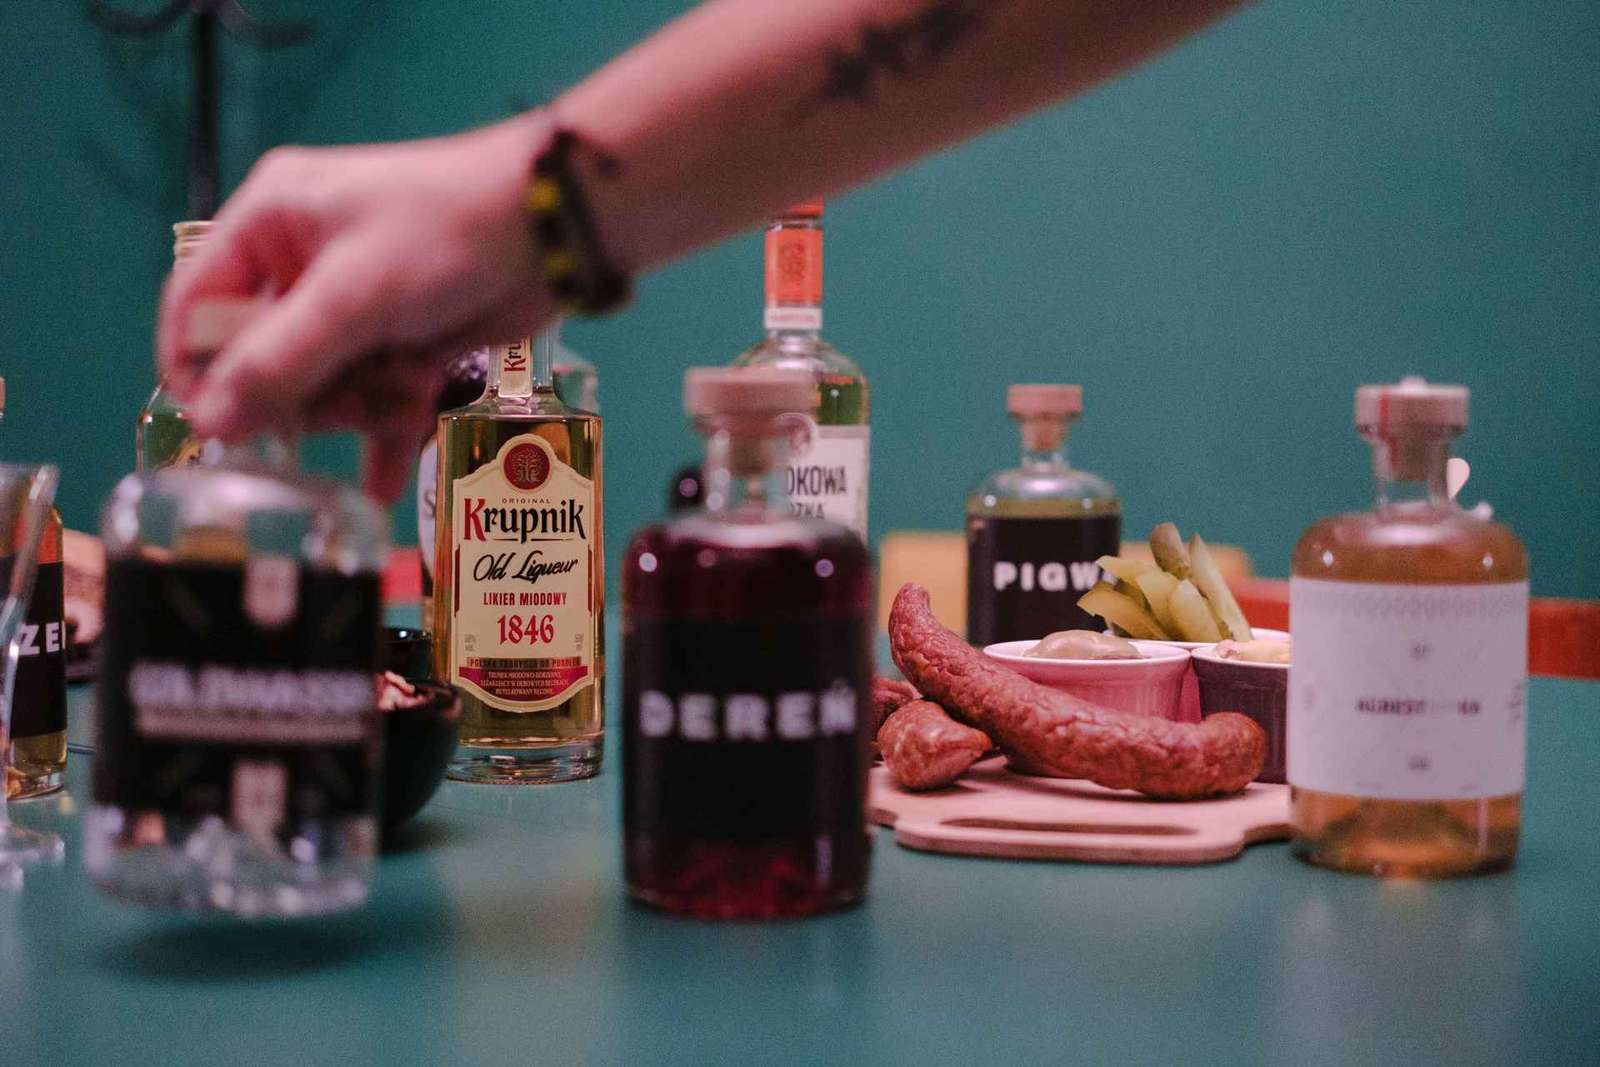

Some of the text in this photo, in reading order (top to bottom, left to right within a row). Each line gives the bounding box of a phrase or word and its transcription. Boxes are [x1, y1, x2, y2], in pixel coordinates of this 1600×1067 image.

[464, 498, 587, 544] Krupnik
[473, 550, 579, 584] Old Liqueur
[484, 592, 567, 605] LIKIER MIODOWY
[497, 614, 554, 645] 1846
